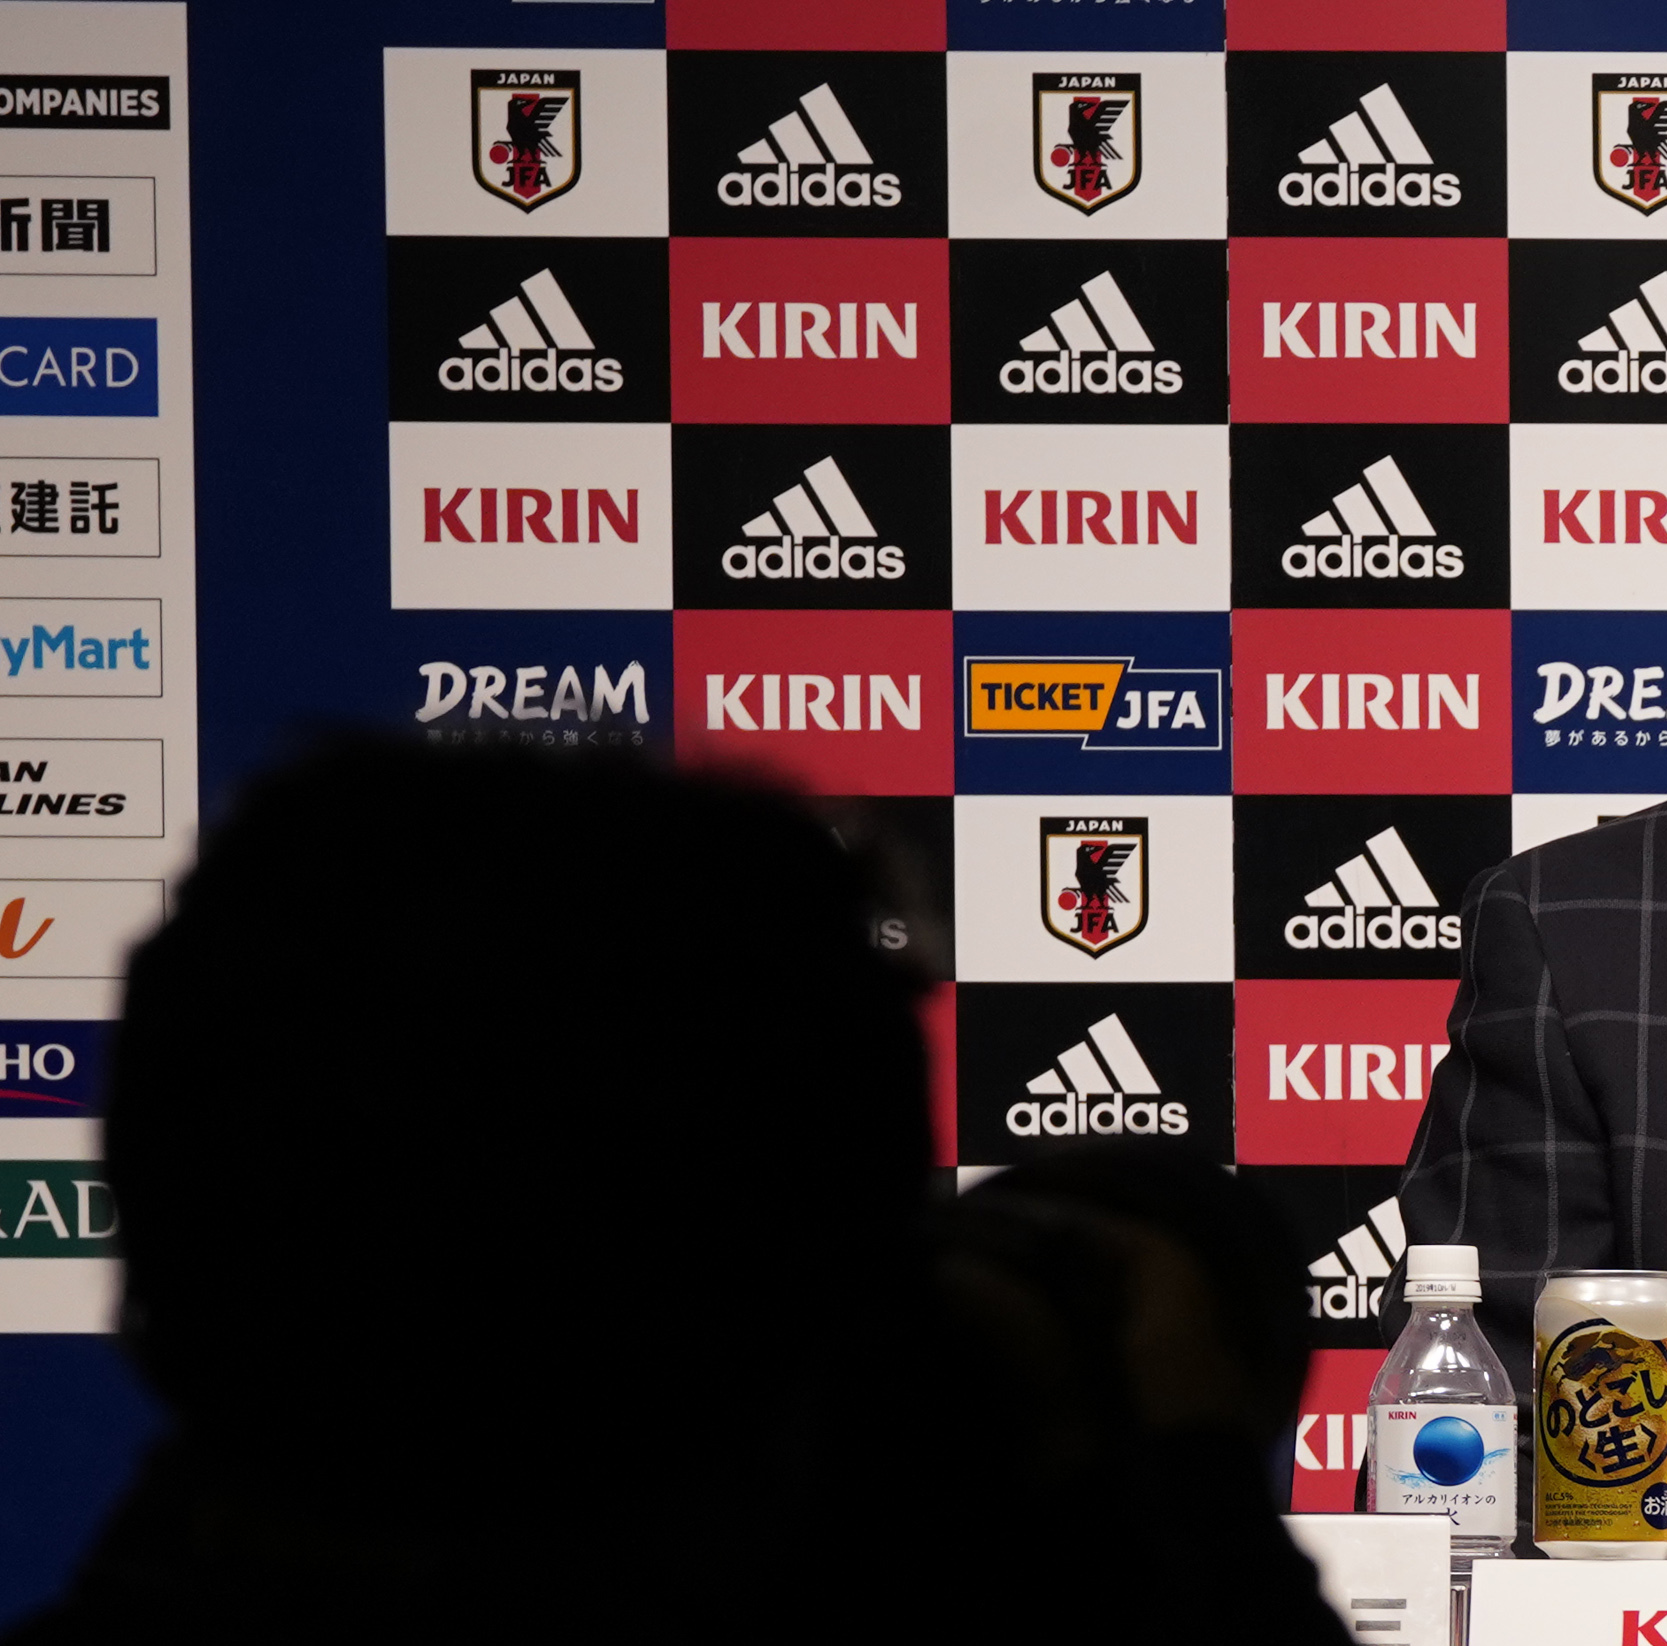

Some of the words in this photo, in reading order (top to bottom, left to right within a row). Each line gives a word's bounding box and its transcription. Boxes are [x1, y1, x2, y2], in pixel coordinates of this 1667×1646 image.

[498, 73, 554, 84] JAPAN
[502, 166, 550, 186] JFA
[718, 163, 901, 206] adidas
[703, 303, 917, 358] KIRIN
[1263, 303, 1476, 358] KIRIN
[0, 346, 139, 388] CARD
[424, 488, 638, 543] KIRIN
[985, 490, 1197, 544] KIRIN
[415, 660, 650, 724] DREAM
[981, 682, 1105, 712] TICKET
[1117, 689, 1206, 730] JFA
[1267, 674, 1479, 729] KIRIN
[1066, 820, 1122, 831] JAPAN
[1070, 914, 1118, 934] JFA
[1285, 906, 1461, 949] adidas
[1388, 1411, 1417, 1420] KIRIN
[1403, 1494, 1496, 1505] アルカリイオンの
